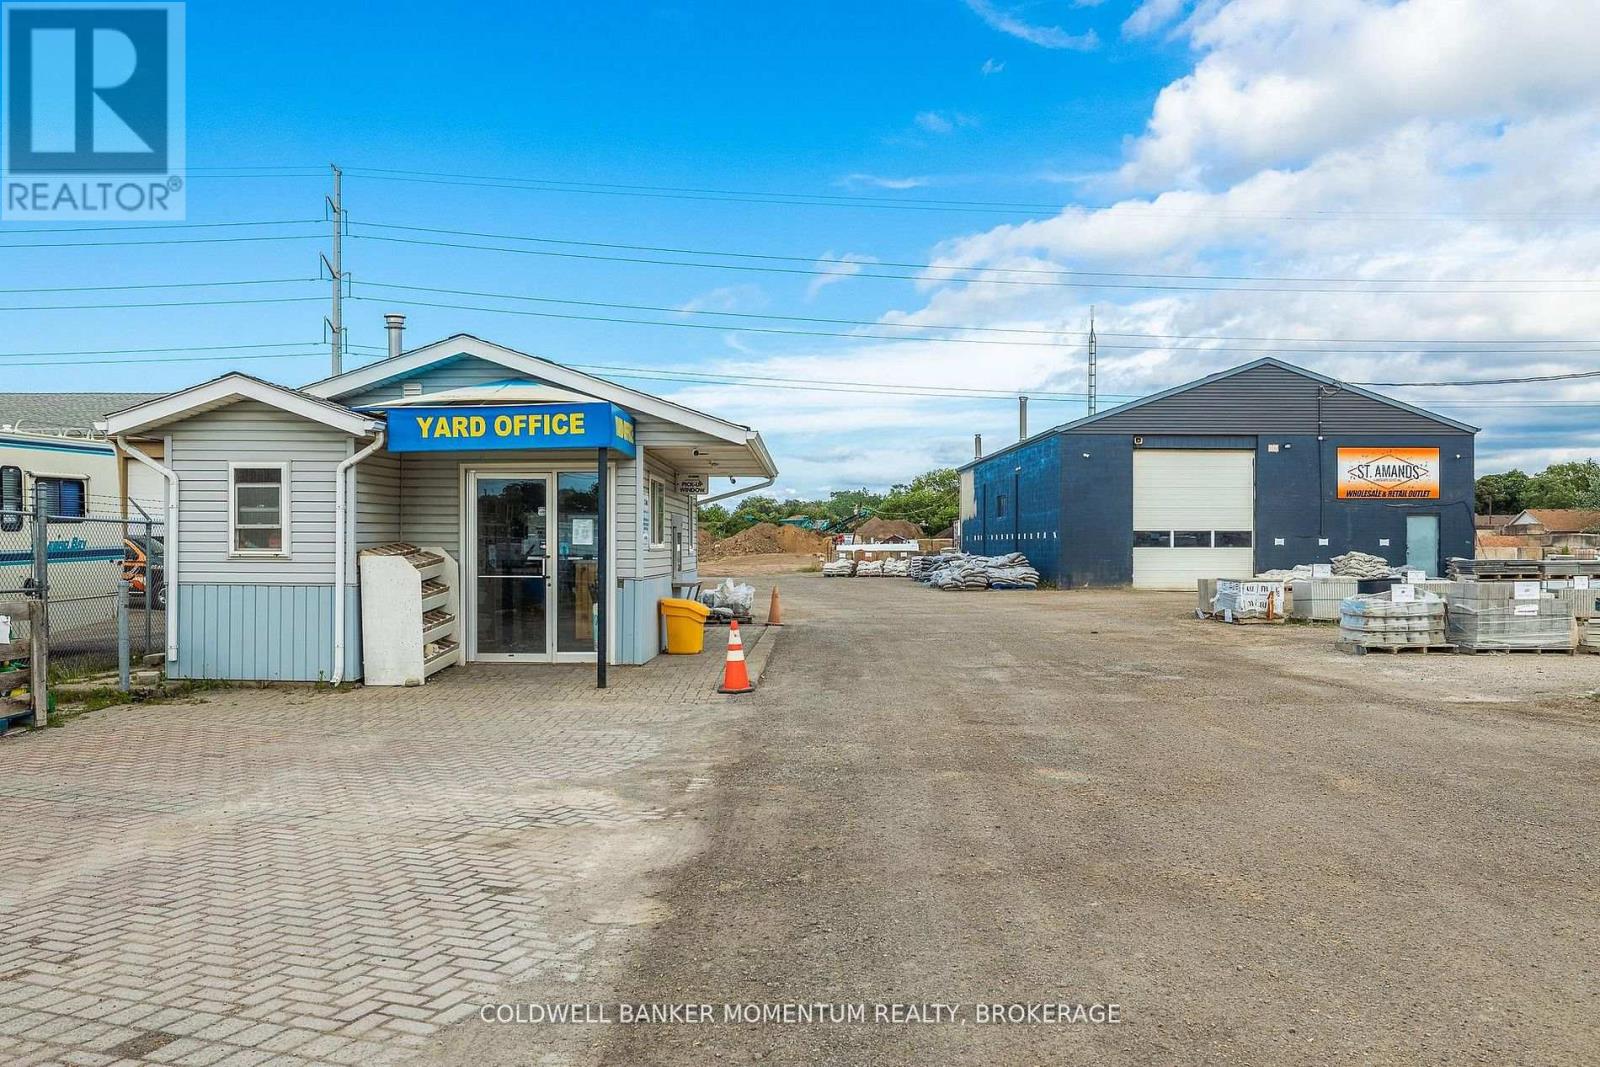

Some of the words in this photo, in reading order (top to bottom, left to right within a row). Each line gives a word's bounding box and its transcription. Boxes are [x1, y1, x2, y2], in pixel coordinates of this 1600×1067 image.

[416, 416, 486, 438] YARD
[494, 413, 585, 436] OFFICE
[1357, 464, 1372, 478] ST.
[1374, 464, 1420, 479] AMANDS
[1346, 489, 1381, 498] WHOLESALE
[1387, 489, 1408, 498] RETAIL
[1408, 489, 1431, 498] OUTLET
